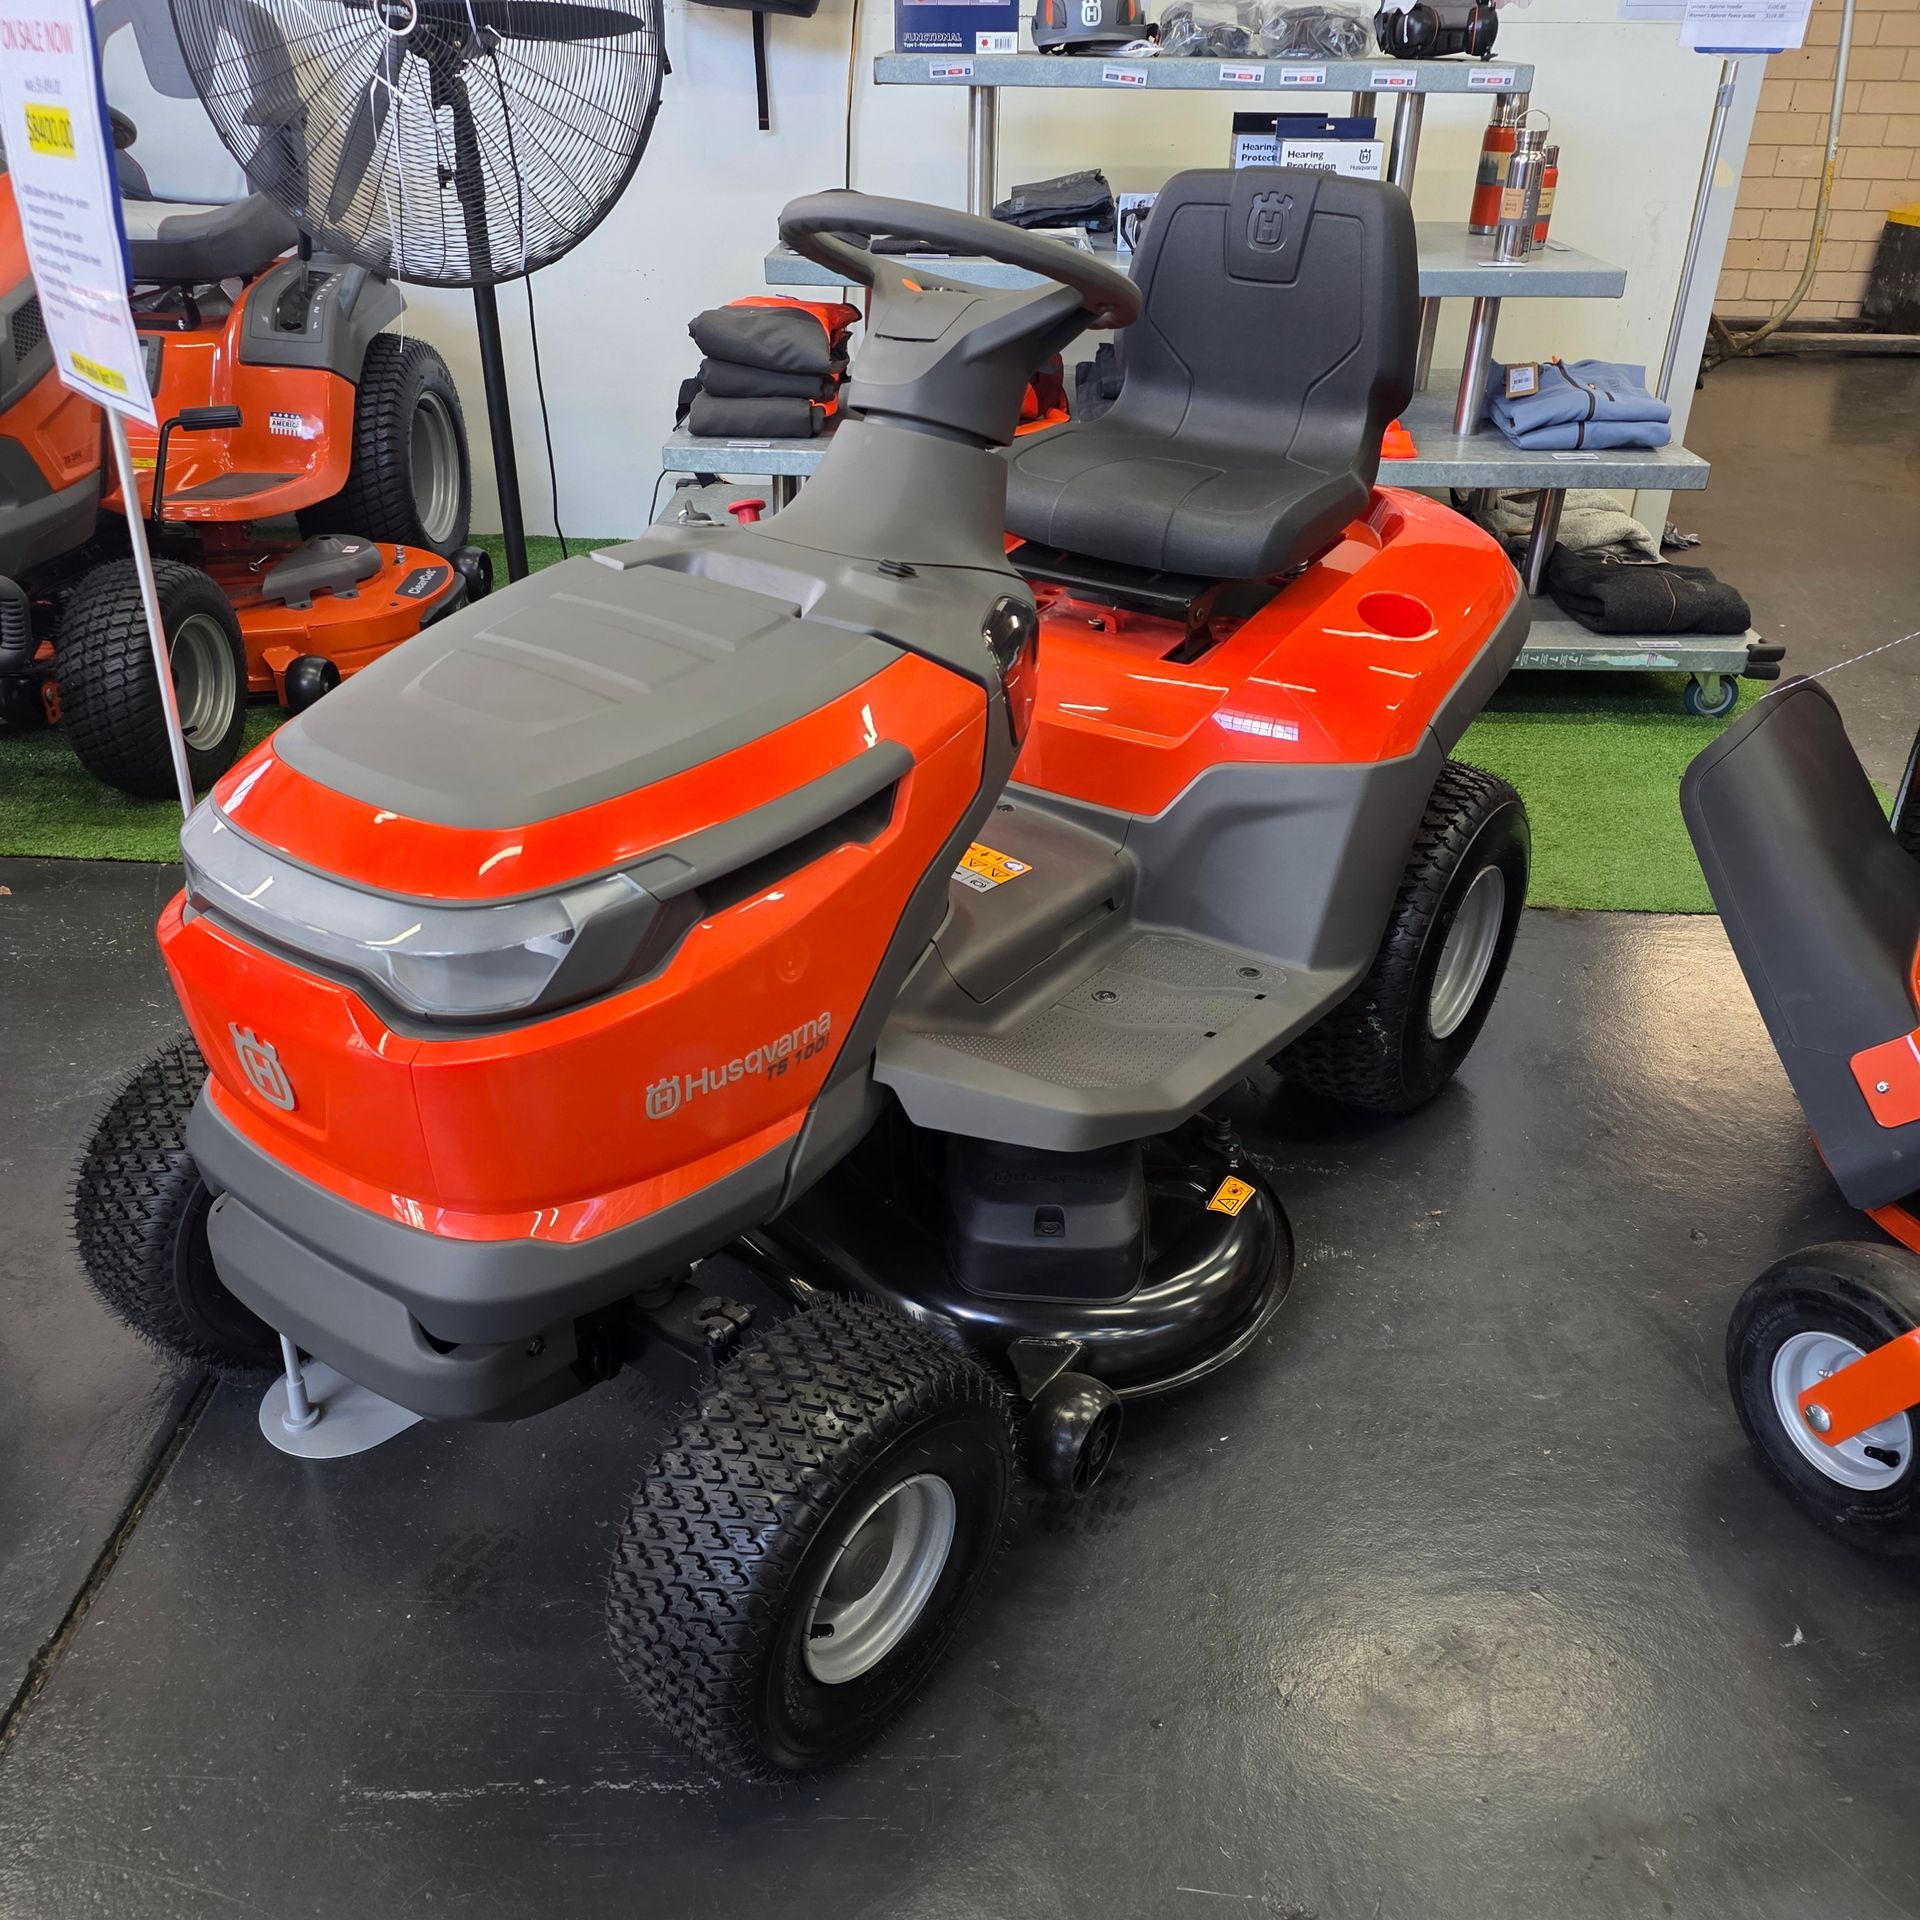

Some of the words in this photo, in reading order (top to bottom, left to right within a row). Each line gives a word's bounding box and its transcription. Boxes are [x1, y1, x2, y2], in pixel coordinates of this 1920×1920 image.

[18, 20, 44, 53] SALE
[45, 22, 73, 55] NOW
[903, 32, 962, 42] FUNCTIONAL
[1242, 143, 1277, 153] Hearing
[1241, 153, 1277, 162] Protect
[1287, 150, 1324, 161] Hearing
[1286, 161, 1337, 170] Protection
[408, 568, 437, 594] ClearCut
[685, 1011, 831, 1101] Husqvarna
[766, 1057, 789, 1081] TS
[795, 1032, 831, 1065] 100i
